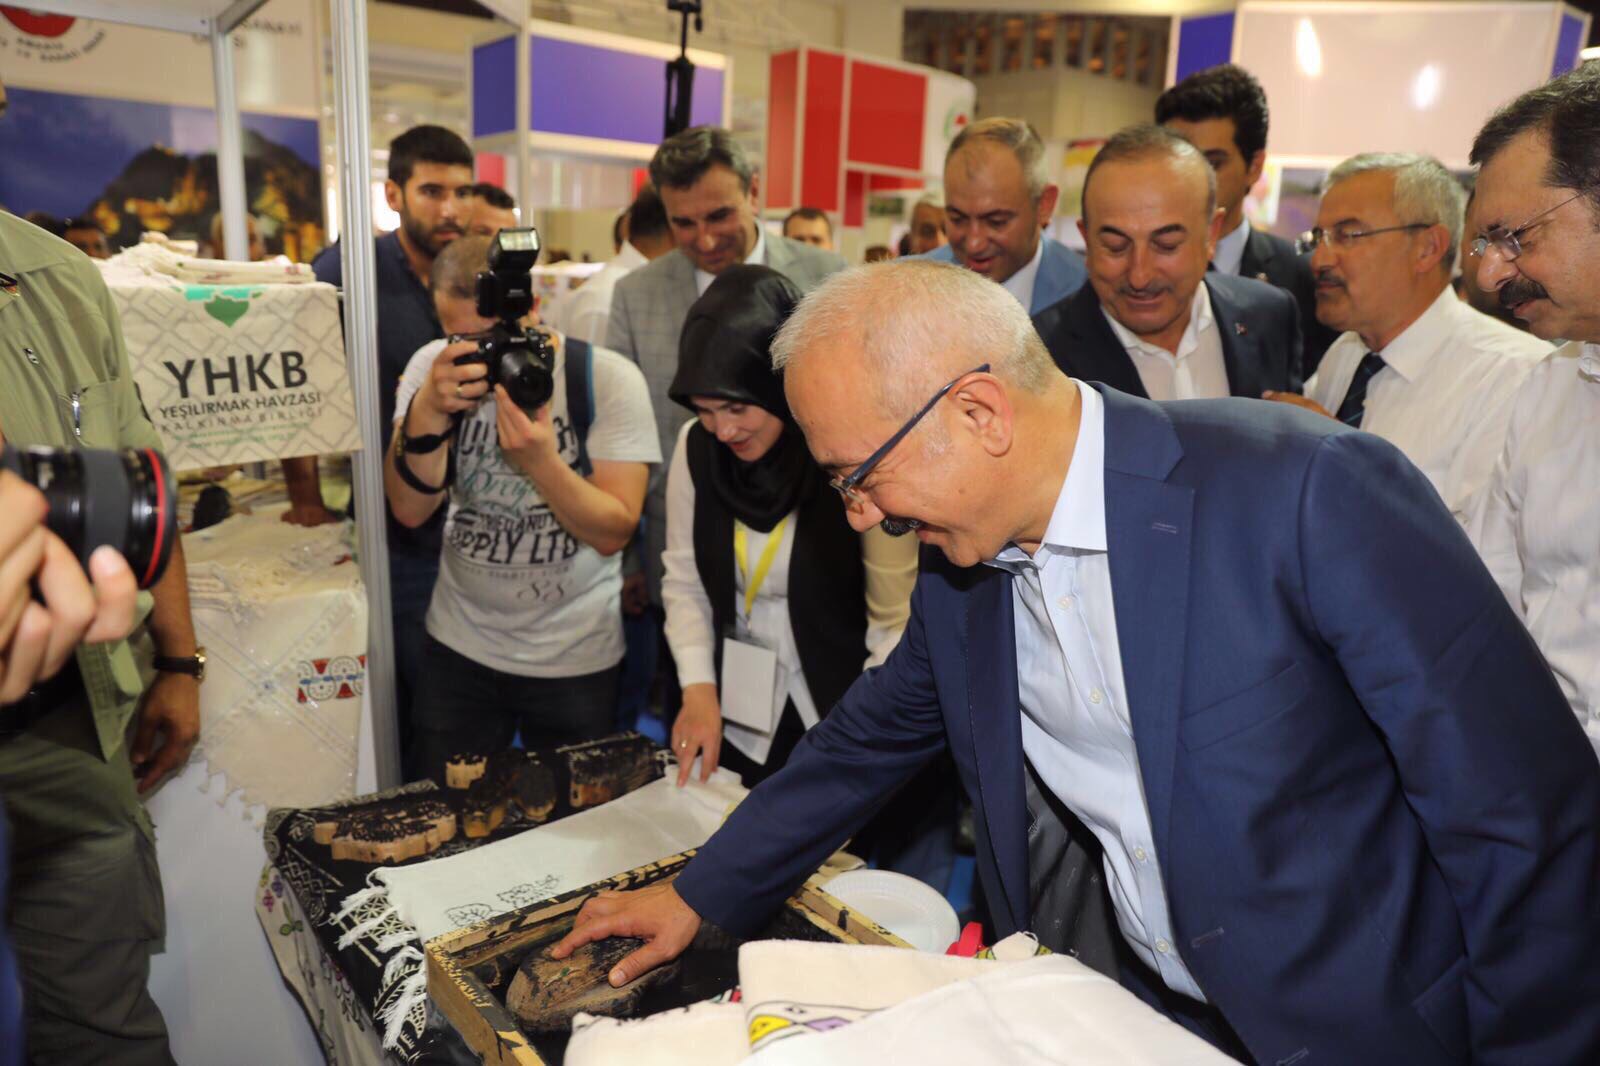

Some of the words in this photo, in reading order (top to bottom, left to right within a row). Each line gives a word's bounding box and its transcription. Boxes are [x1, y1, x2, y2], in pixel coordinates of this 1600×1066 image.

[163, 350, 308, 399] YHKB
[255, 391, 321, 409] HAVZASI
[529, 527, 579, 564] LTD
